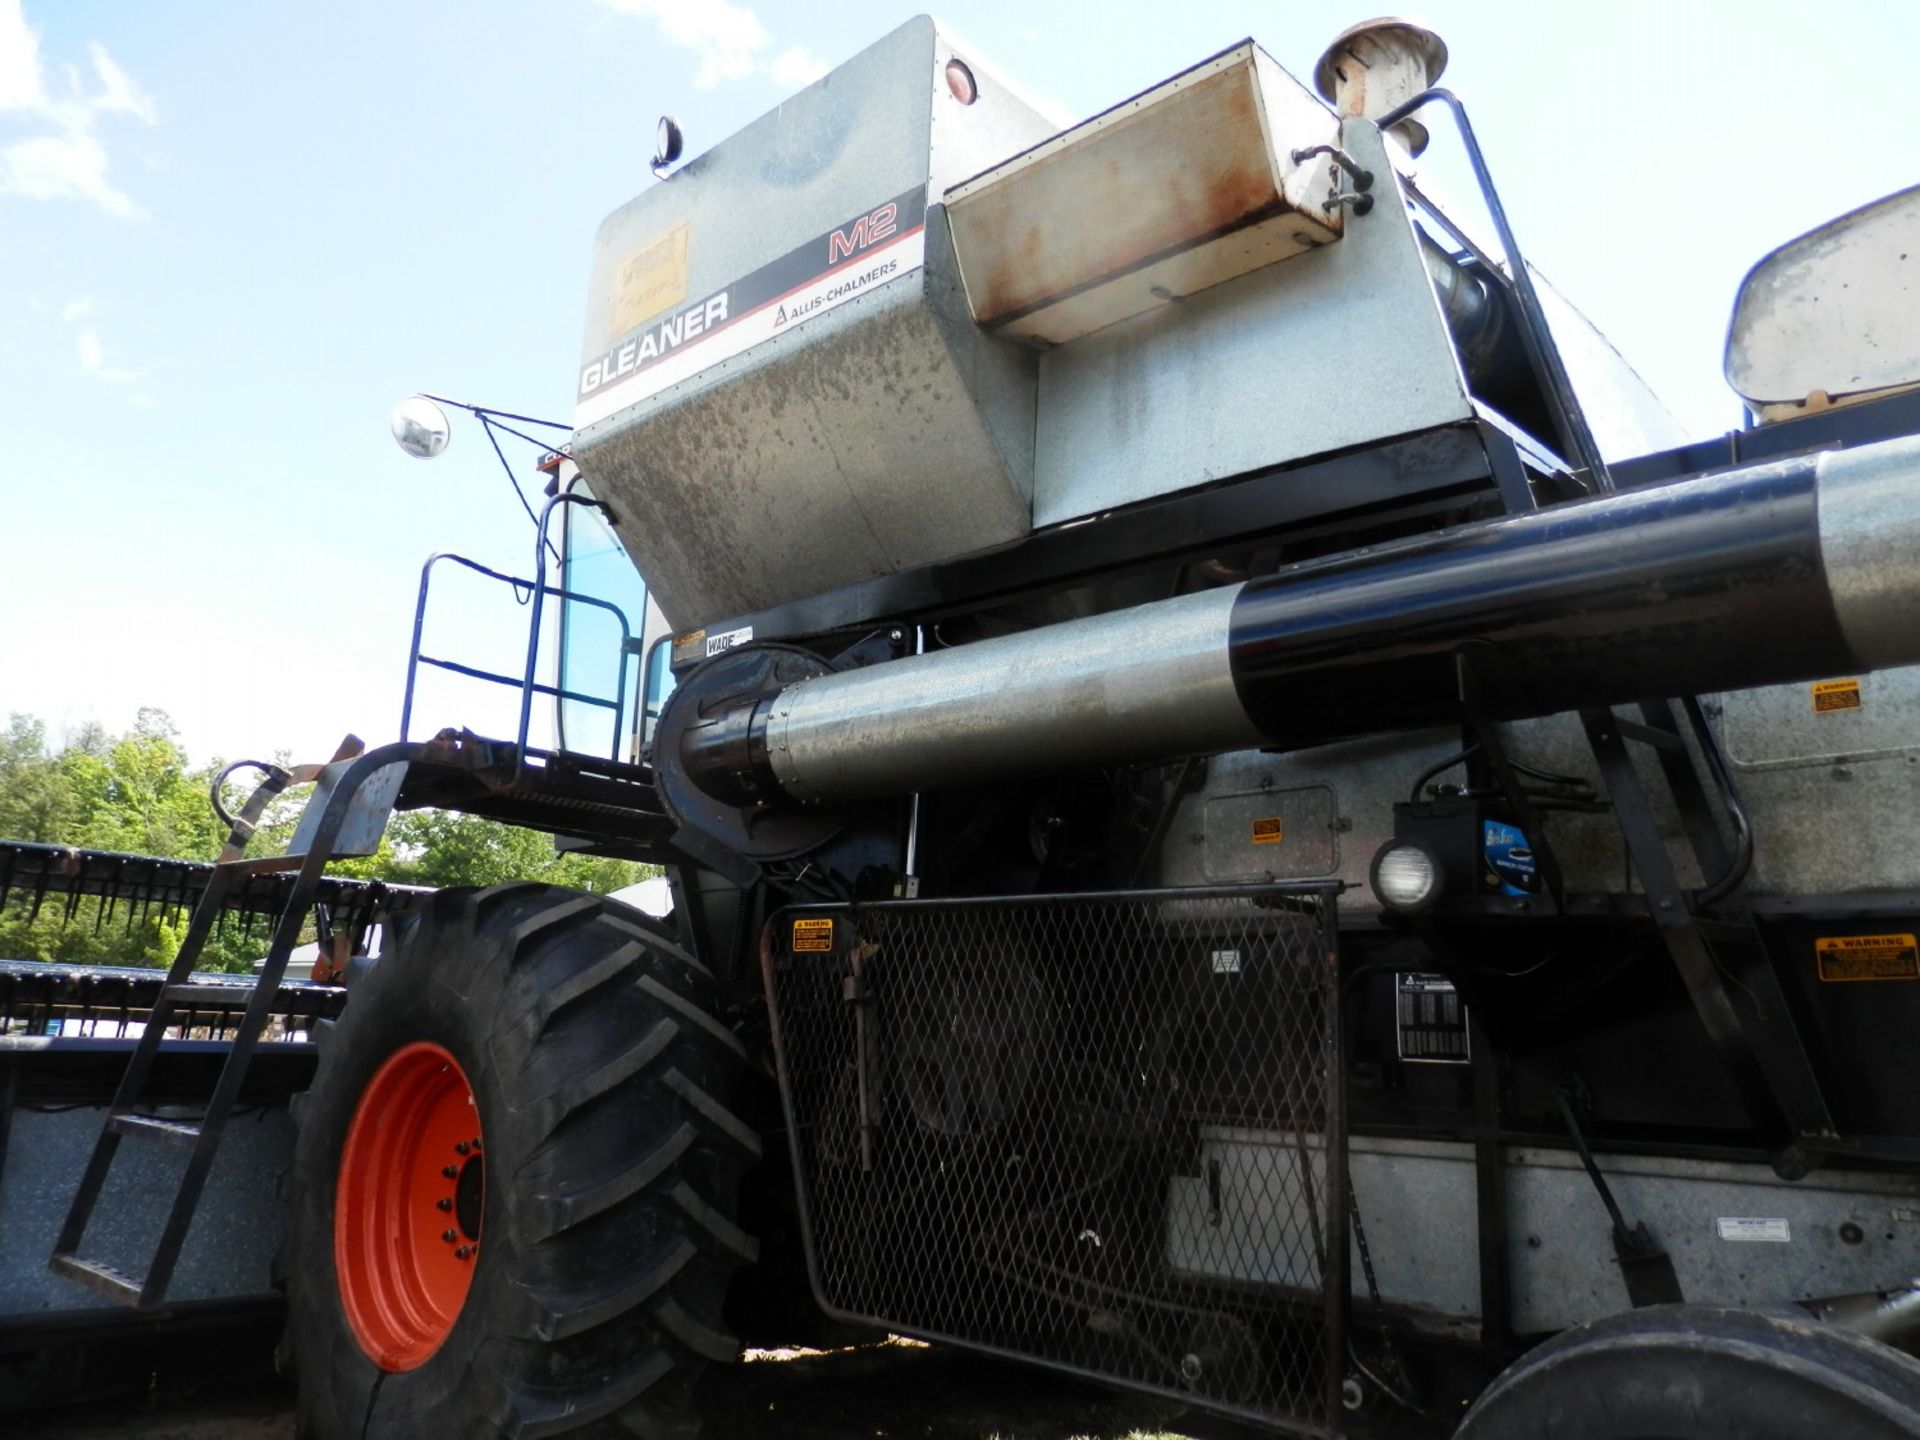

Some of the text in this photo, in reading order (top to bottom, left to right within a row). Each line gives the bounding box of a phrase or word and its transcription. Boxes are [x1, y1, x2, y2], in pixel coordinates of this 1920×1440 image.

[829, 202, 898, 265] M2
[790, 258, 898, 320] ALLIS-CHALMERS
[580, 291, 730, 395] GLEANER
[1842, 937, 1905, 949] WARNING
